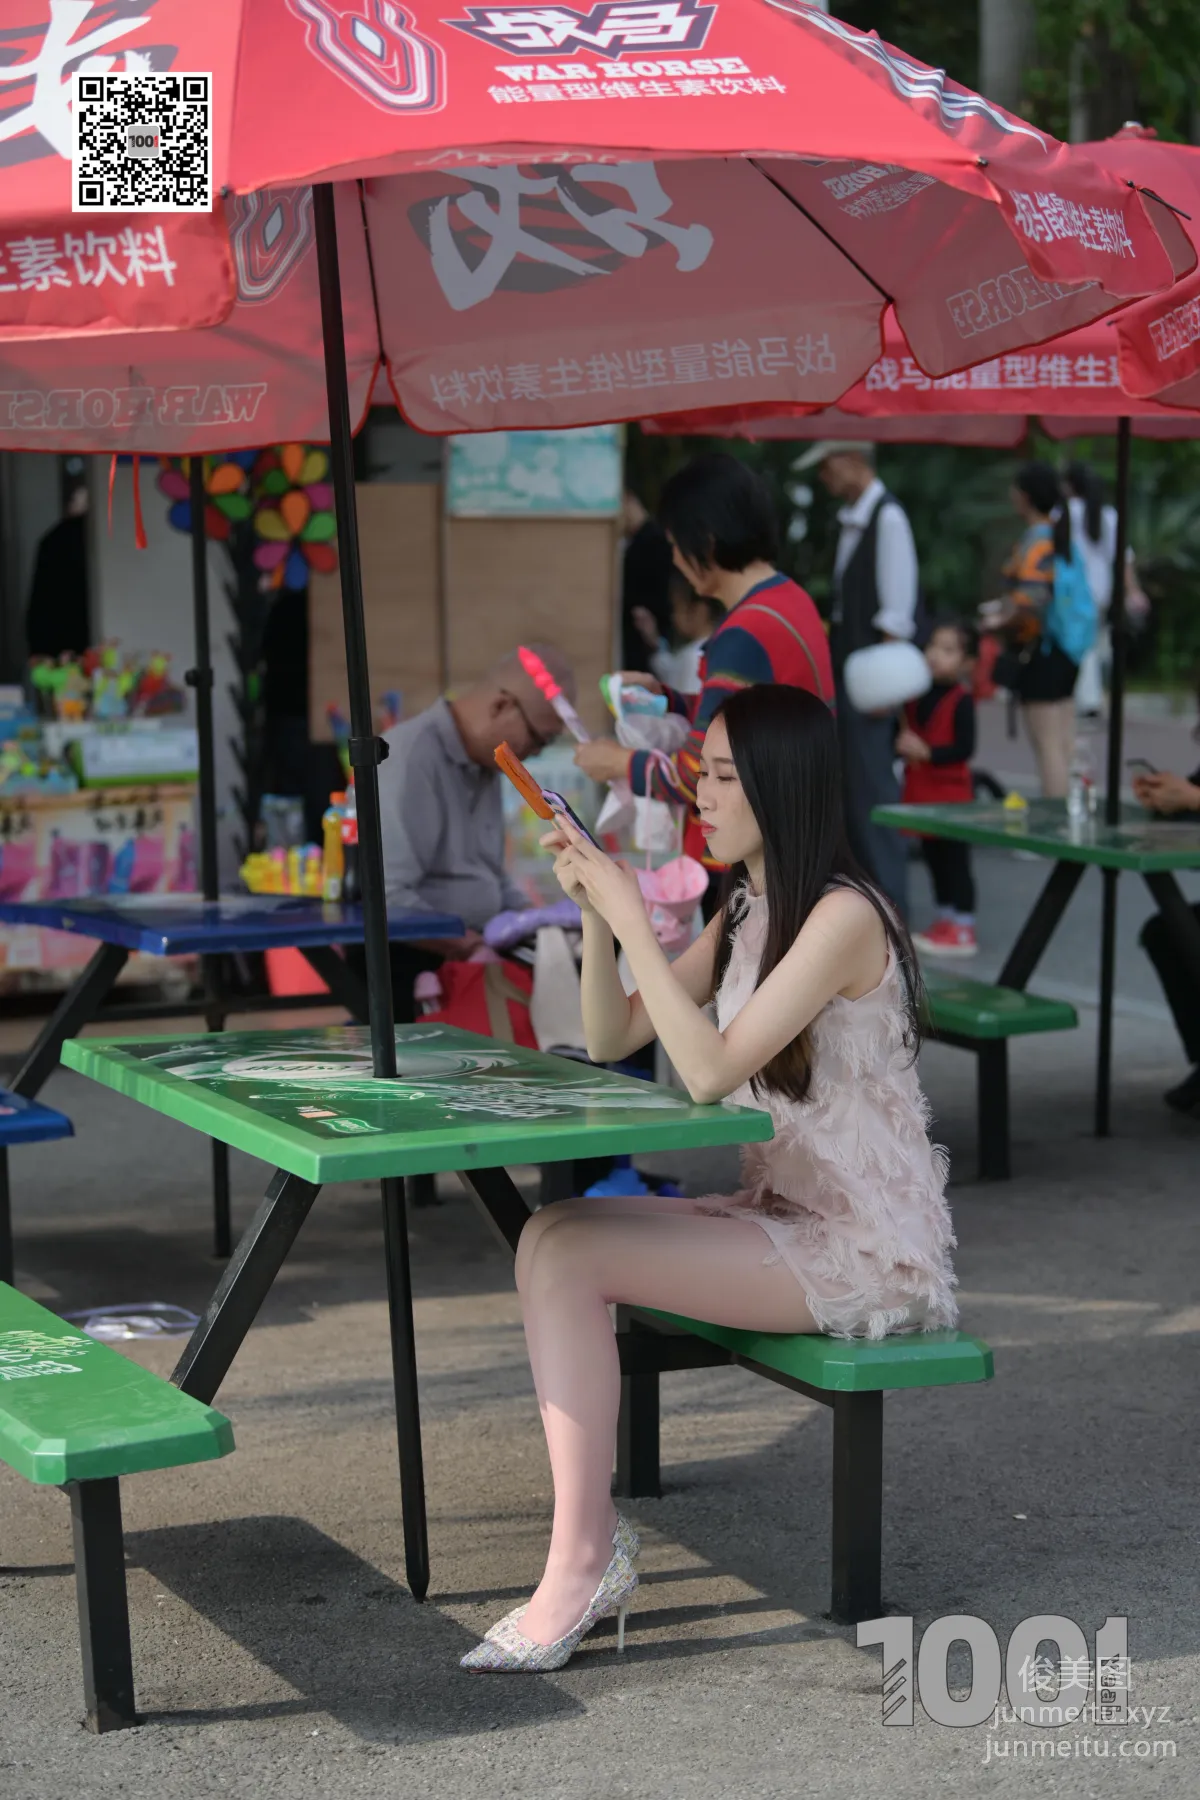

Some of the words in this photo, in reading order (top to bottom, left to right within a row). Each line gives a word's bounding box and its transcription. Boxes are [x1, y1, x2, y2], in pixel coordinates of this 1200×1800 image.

[494, 63, 598, 82] WAR
[597, 57, 751, 79] HORSE
[487, 76, 787, 104] 能量型维生素饮料
